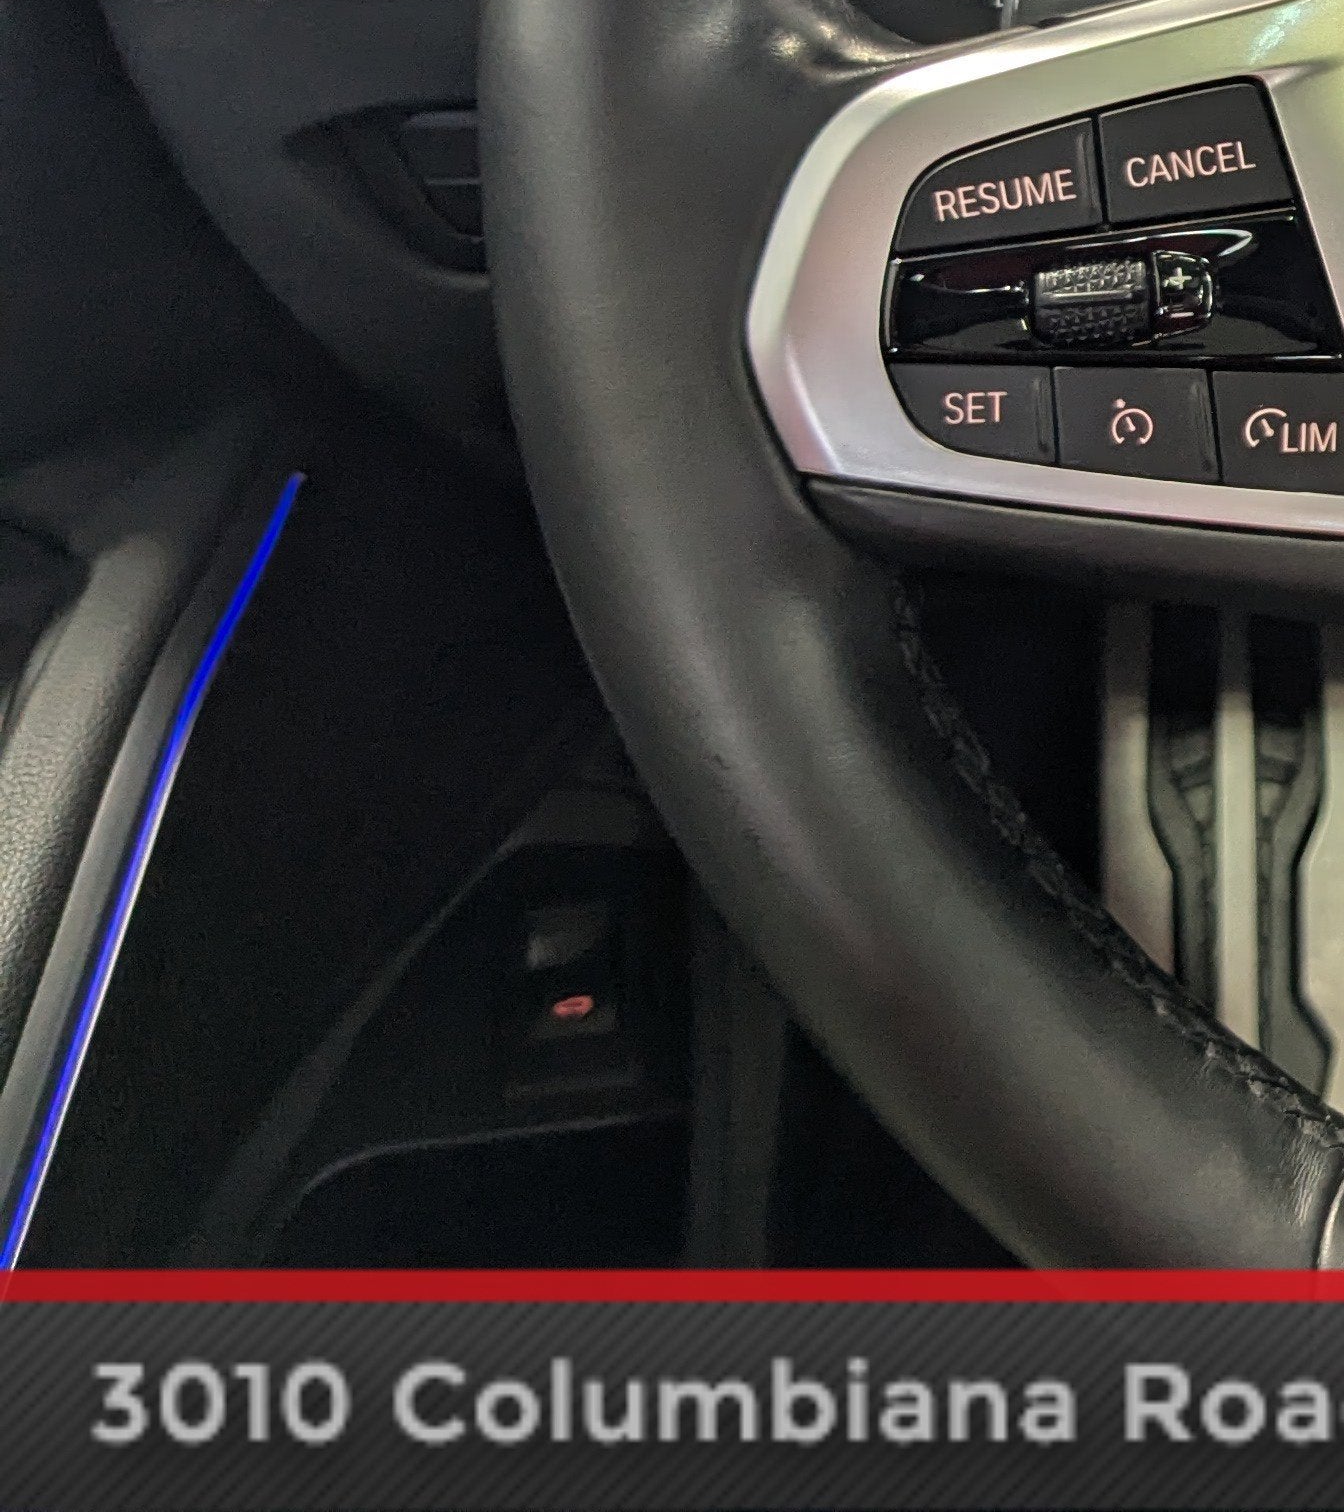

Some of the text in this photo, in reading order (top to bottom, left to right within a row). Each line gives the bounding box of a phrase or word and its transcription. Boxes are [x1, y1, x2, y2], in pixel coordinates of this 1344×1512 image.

[1126, 141, 1256, 188] CANCEL
[933, 169, 1077, 222] RESUME
[944, 391, 1006, 425] SET
[1280, 422, 1338, 453] LIM
